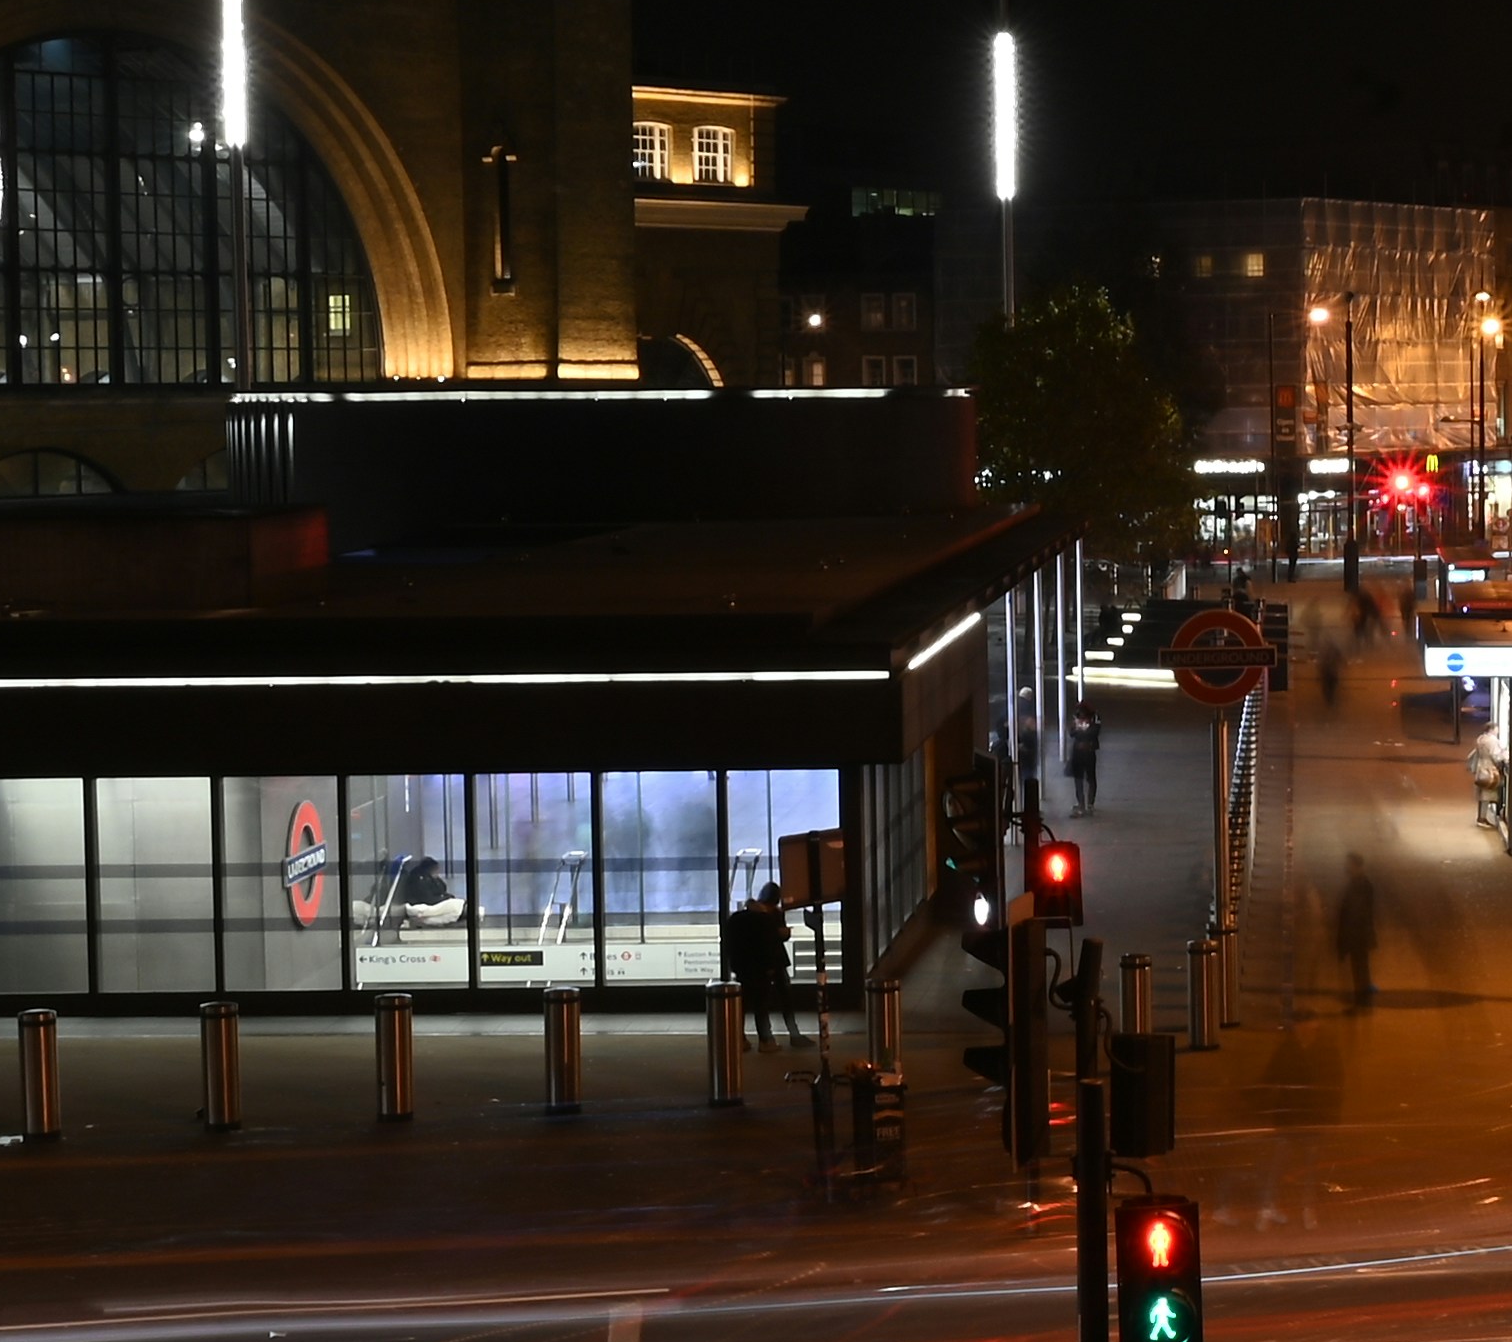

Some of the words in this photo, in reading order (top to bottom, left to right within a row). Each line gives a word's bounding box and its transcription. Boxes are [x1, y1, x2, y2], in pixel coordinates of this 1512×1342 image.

[1164, 651, 1270, 663] UNDERGROUND
[368, 954, 397, 965] King's
[399, 955, 427, 963] Cross
[491, 953, 512, 964] Way
[514, 954, 532, 963] out
